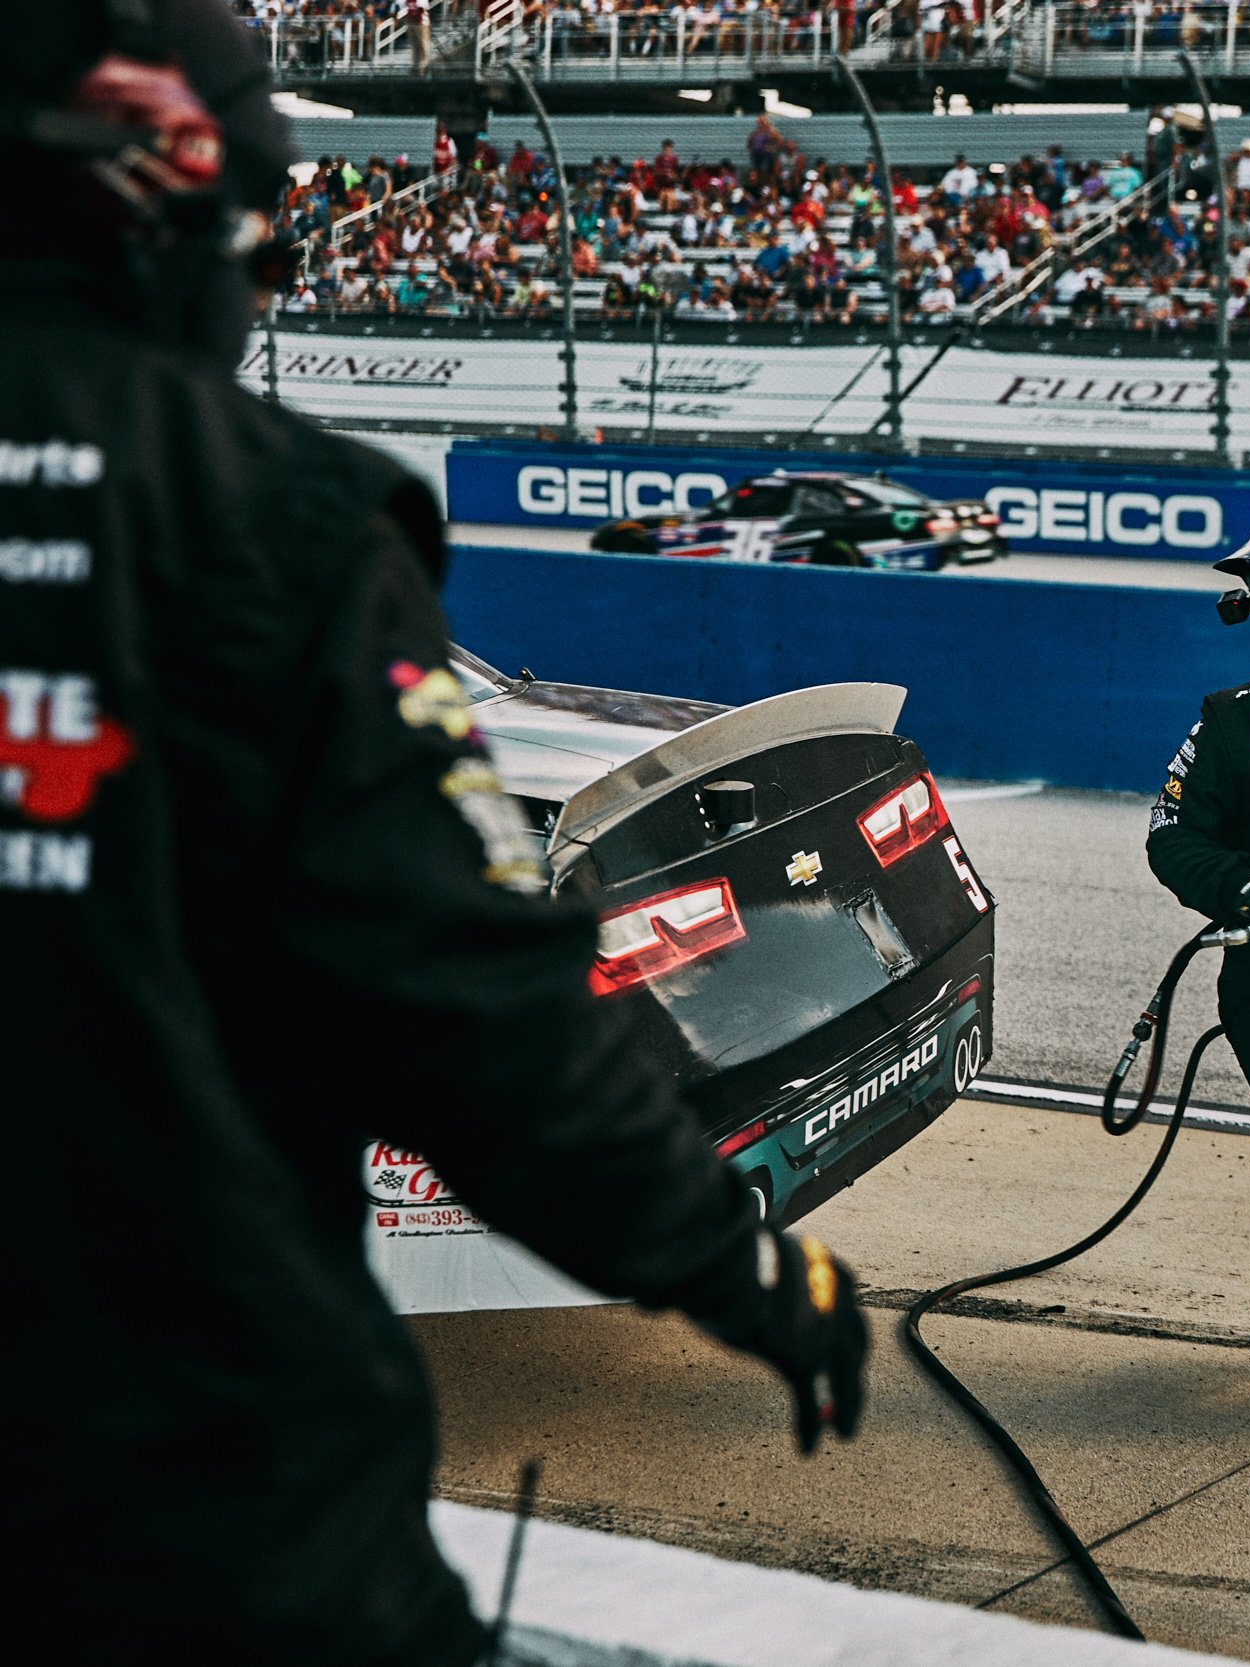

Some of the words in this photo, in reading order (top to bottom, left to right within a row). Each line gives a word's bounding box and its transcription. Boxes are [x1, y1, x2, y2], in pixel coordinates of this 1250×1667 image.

[517, 465, 727, 519] GEICO
[985, 486, 1223, 549] GEICO
[942, 835, 988, 914] 5
[804, 1034, 939, 1146] CAMARO
